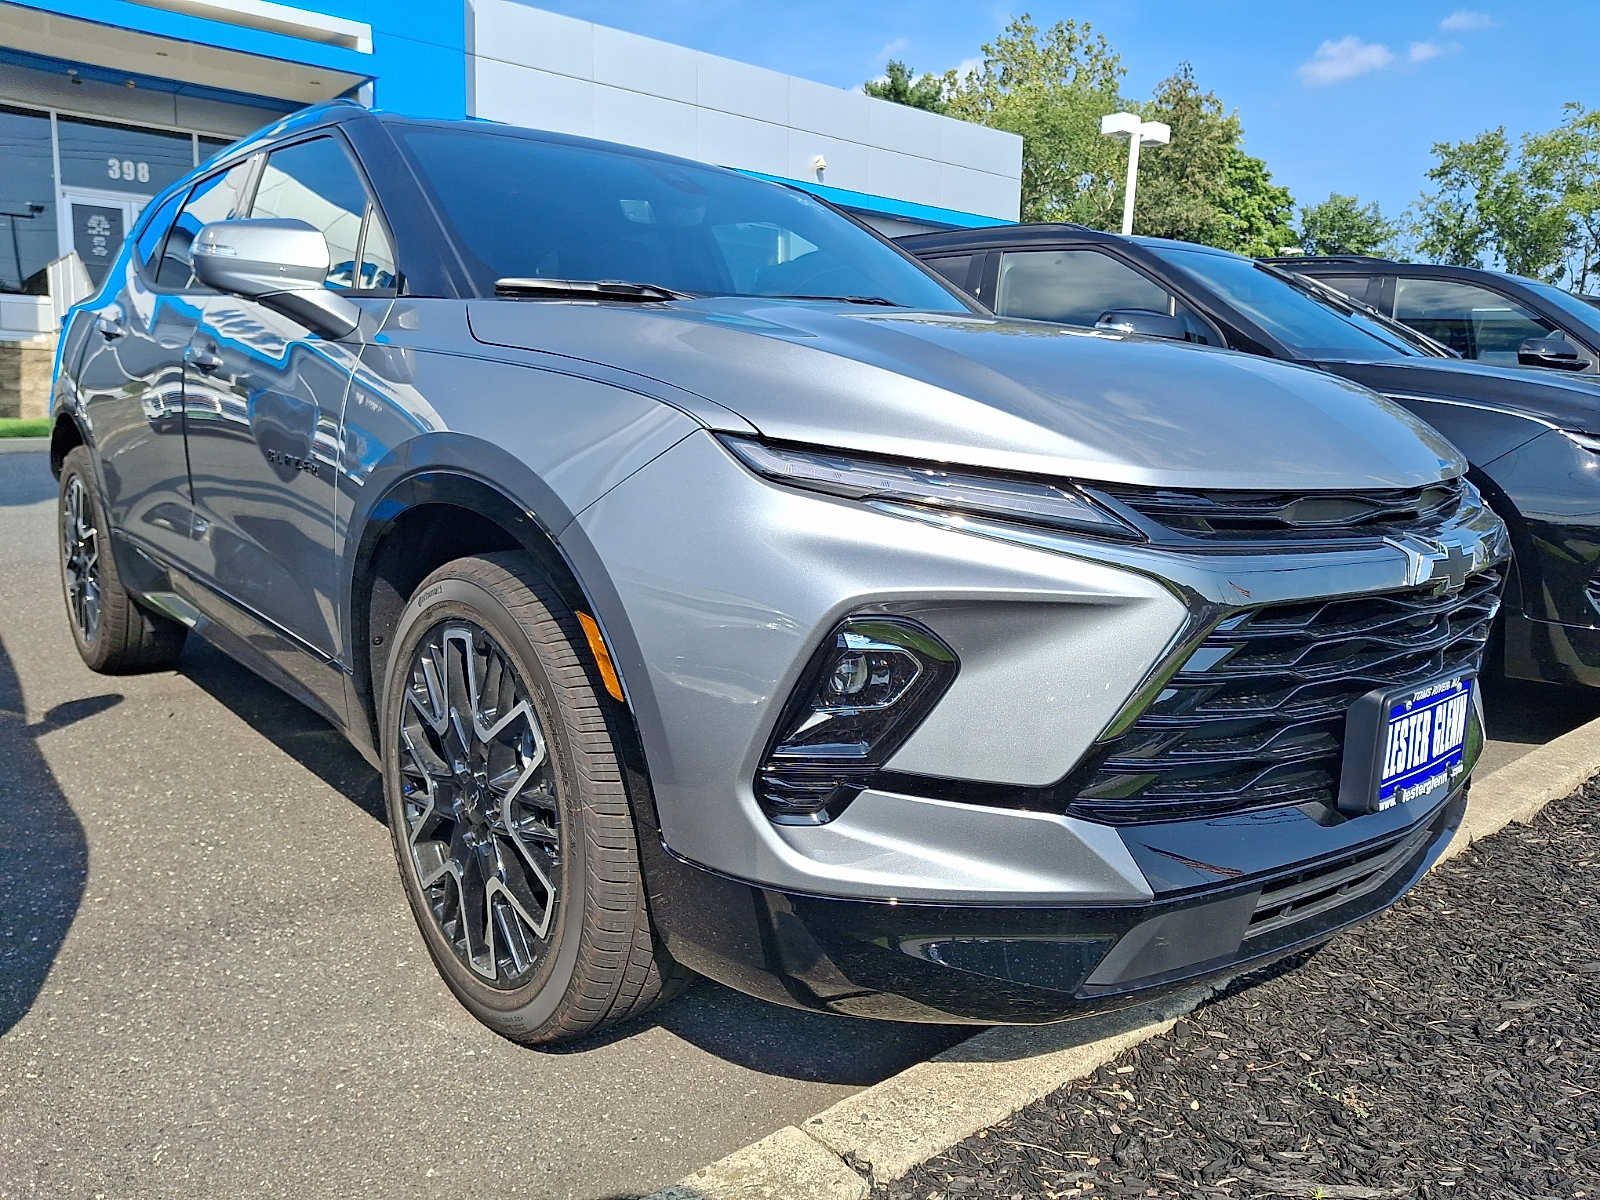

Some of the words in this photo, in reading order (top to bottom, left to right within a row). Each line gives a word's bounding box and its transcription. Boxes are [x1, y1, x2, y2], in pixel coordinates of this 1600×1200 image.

[108, 158, 149, 182] 398
[1383, 710, 1431, 780] LESTER
[1433, 694, 1468, 758] GLENN
